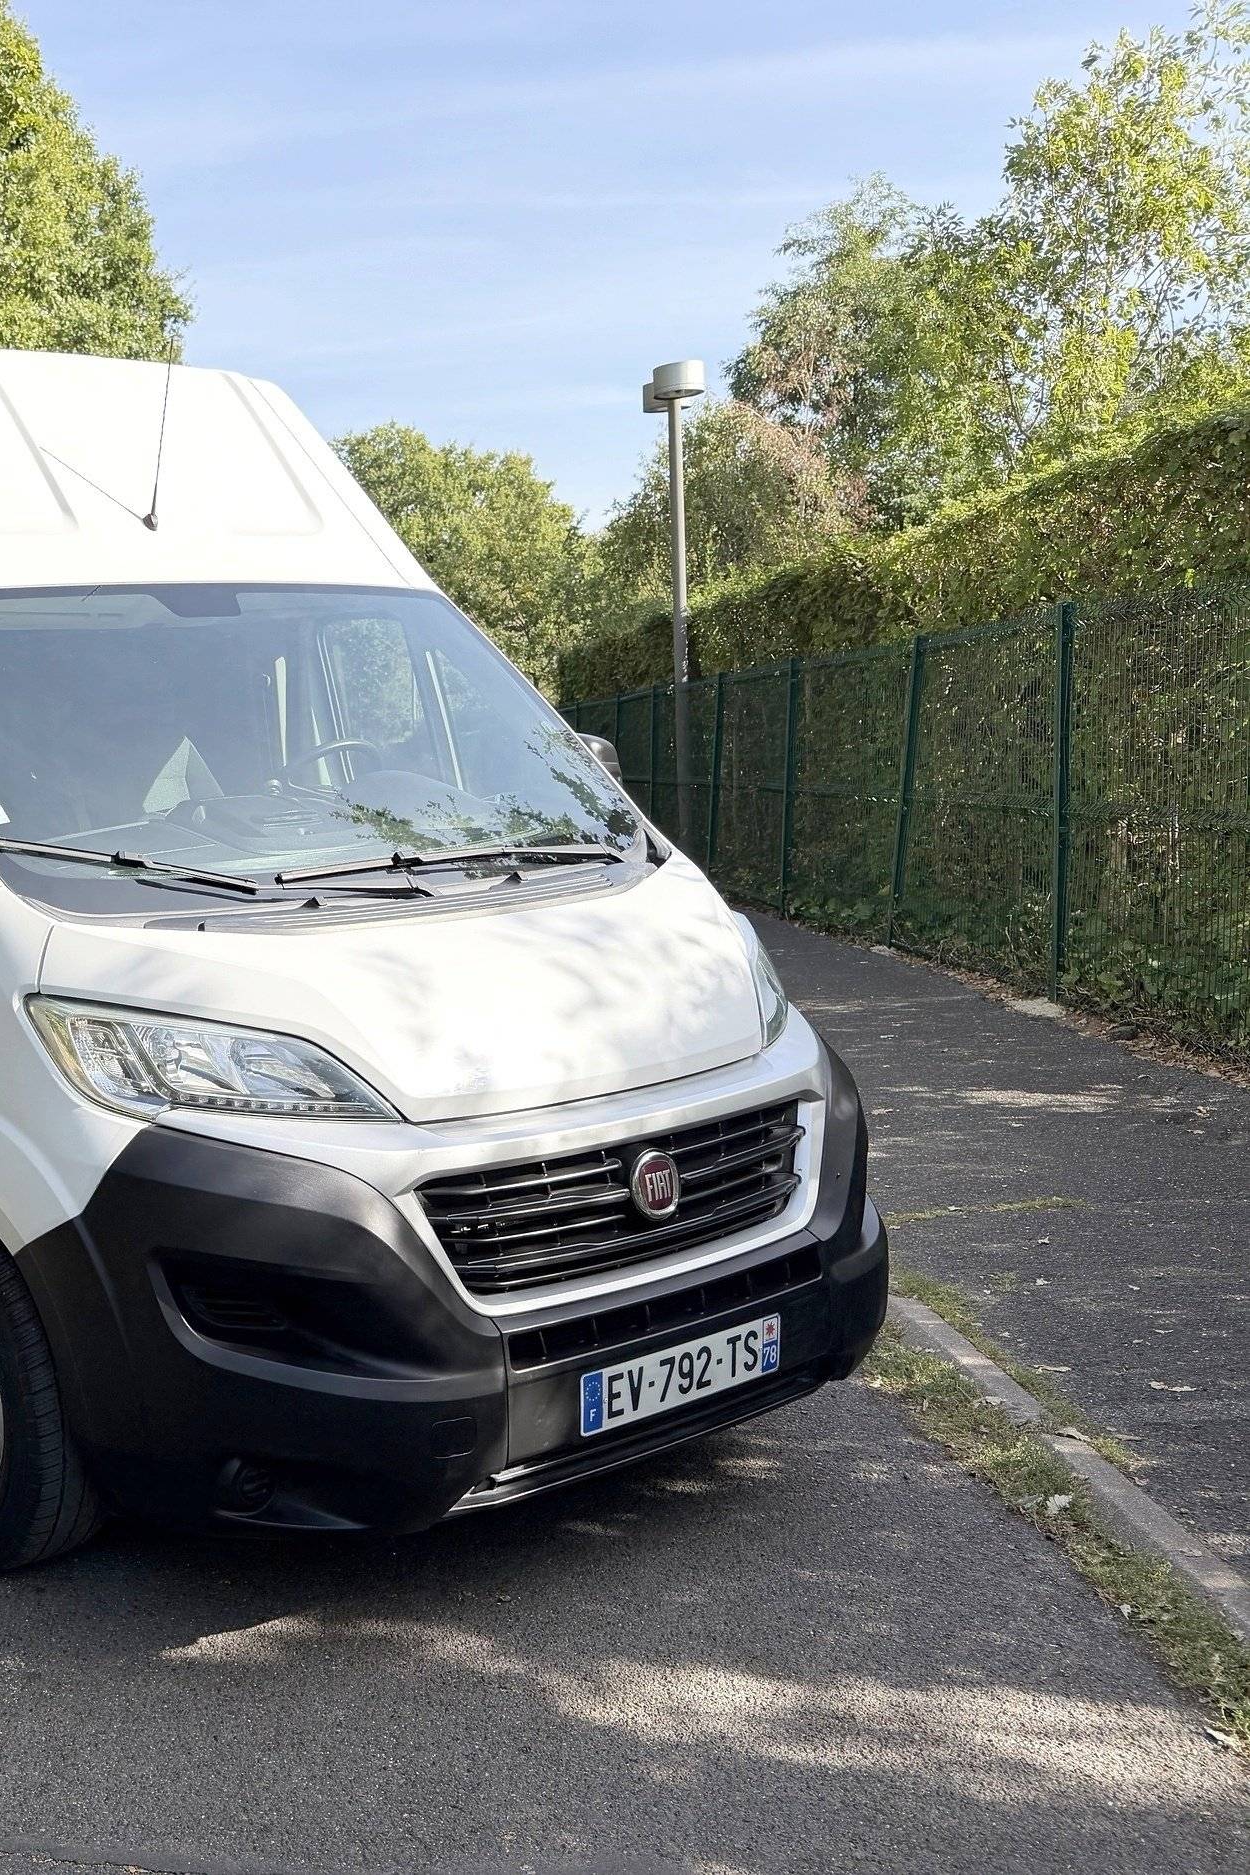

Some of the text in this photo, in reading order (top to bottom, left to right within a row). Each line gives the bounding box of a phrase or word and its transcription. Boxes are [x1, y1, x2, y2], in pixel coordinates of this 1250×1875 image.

[644, 1169, 671, 1202] FIAT
[589, 1330, 777, 1422] F EV-792-TS 78
